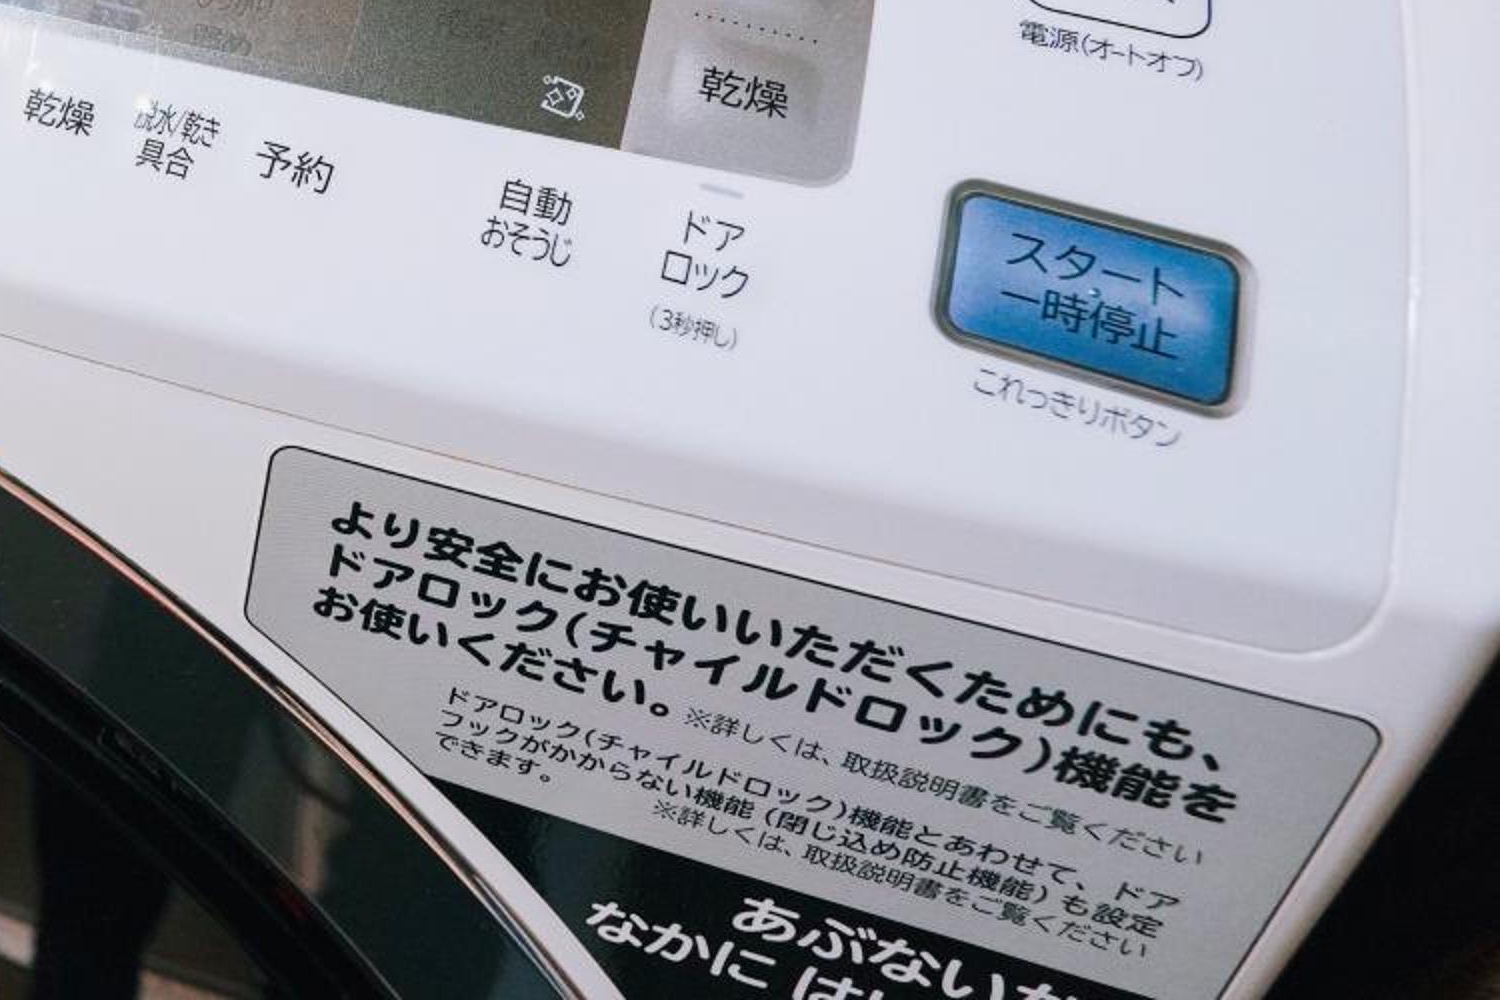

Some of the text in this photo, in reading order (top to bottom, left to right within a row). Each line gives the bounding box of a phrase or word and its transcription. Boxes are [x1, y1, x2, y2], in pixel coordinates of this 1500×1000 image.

[24, 87, 98, 137] 乾燥
[701, 67, 790, 120] 乾燥
[136, 138, 195, 180] 具合
[255, 141, 335, 196] 予約
[498, 179, 574, 226] 自動
[478, 215, 573, 269] おそうじ
[682, 211, 745, 251] ドア
[660, 253, 750, 301] ロック
[1005, 231, 1185, 301] スタート
[999, 285, 1180, 361] 一時停止
[972, 367, 1183, 450] これっきりボタン
[313, 586, 671, 718] お使いください。
[331, 500, 1220, 772] より安全にお使いいただくためにも、
[434, 731, 553, 785] できます。
[585, 900, 884, 1000] なかに は
